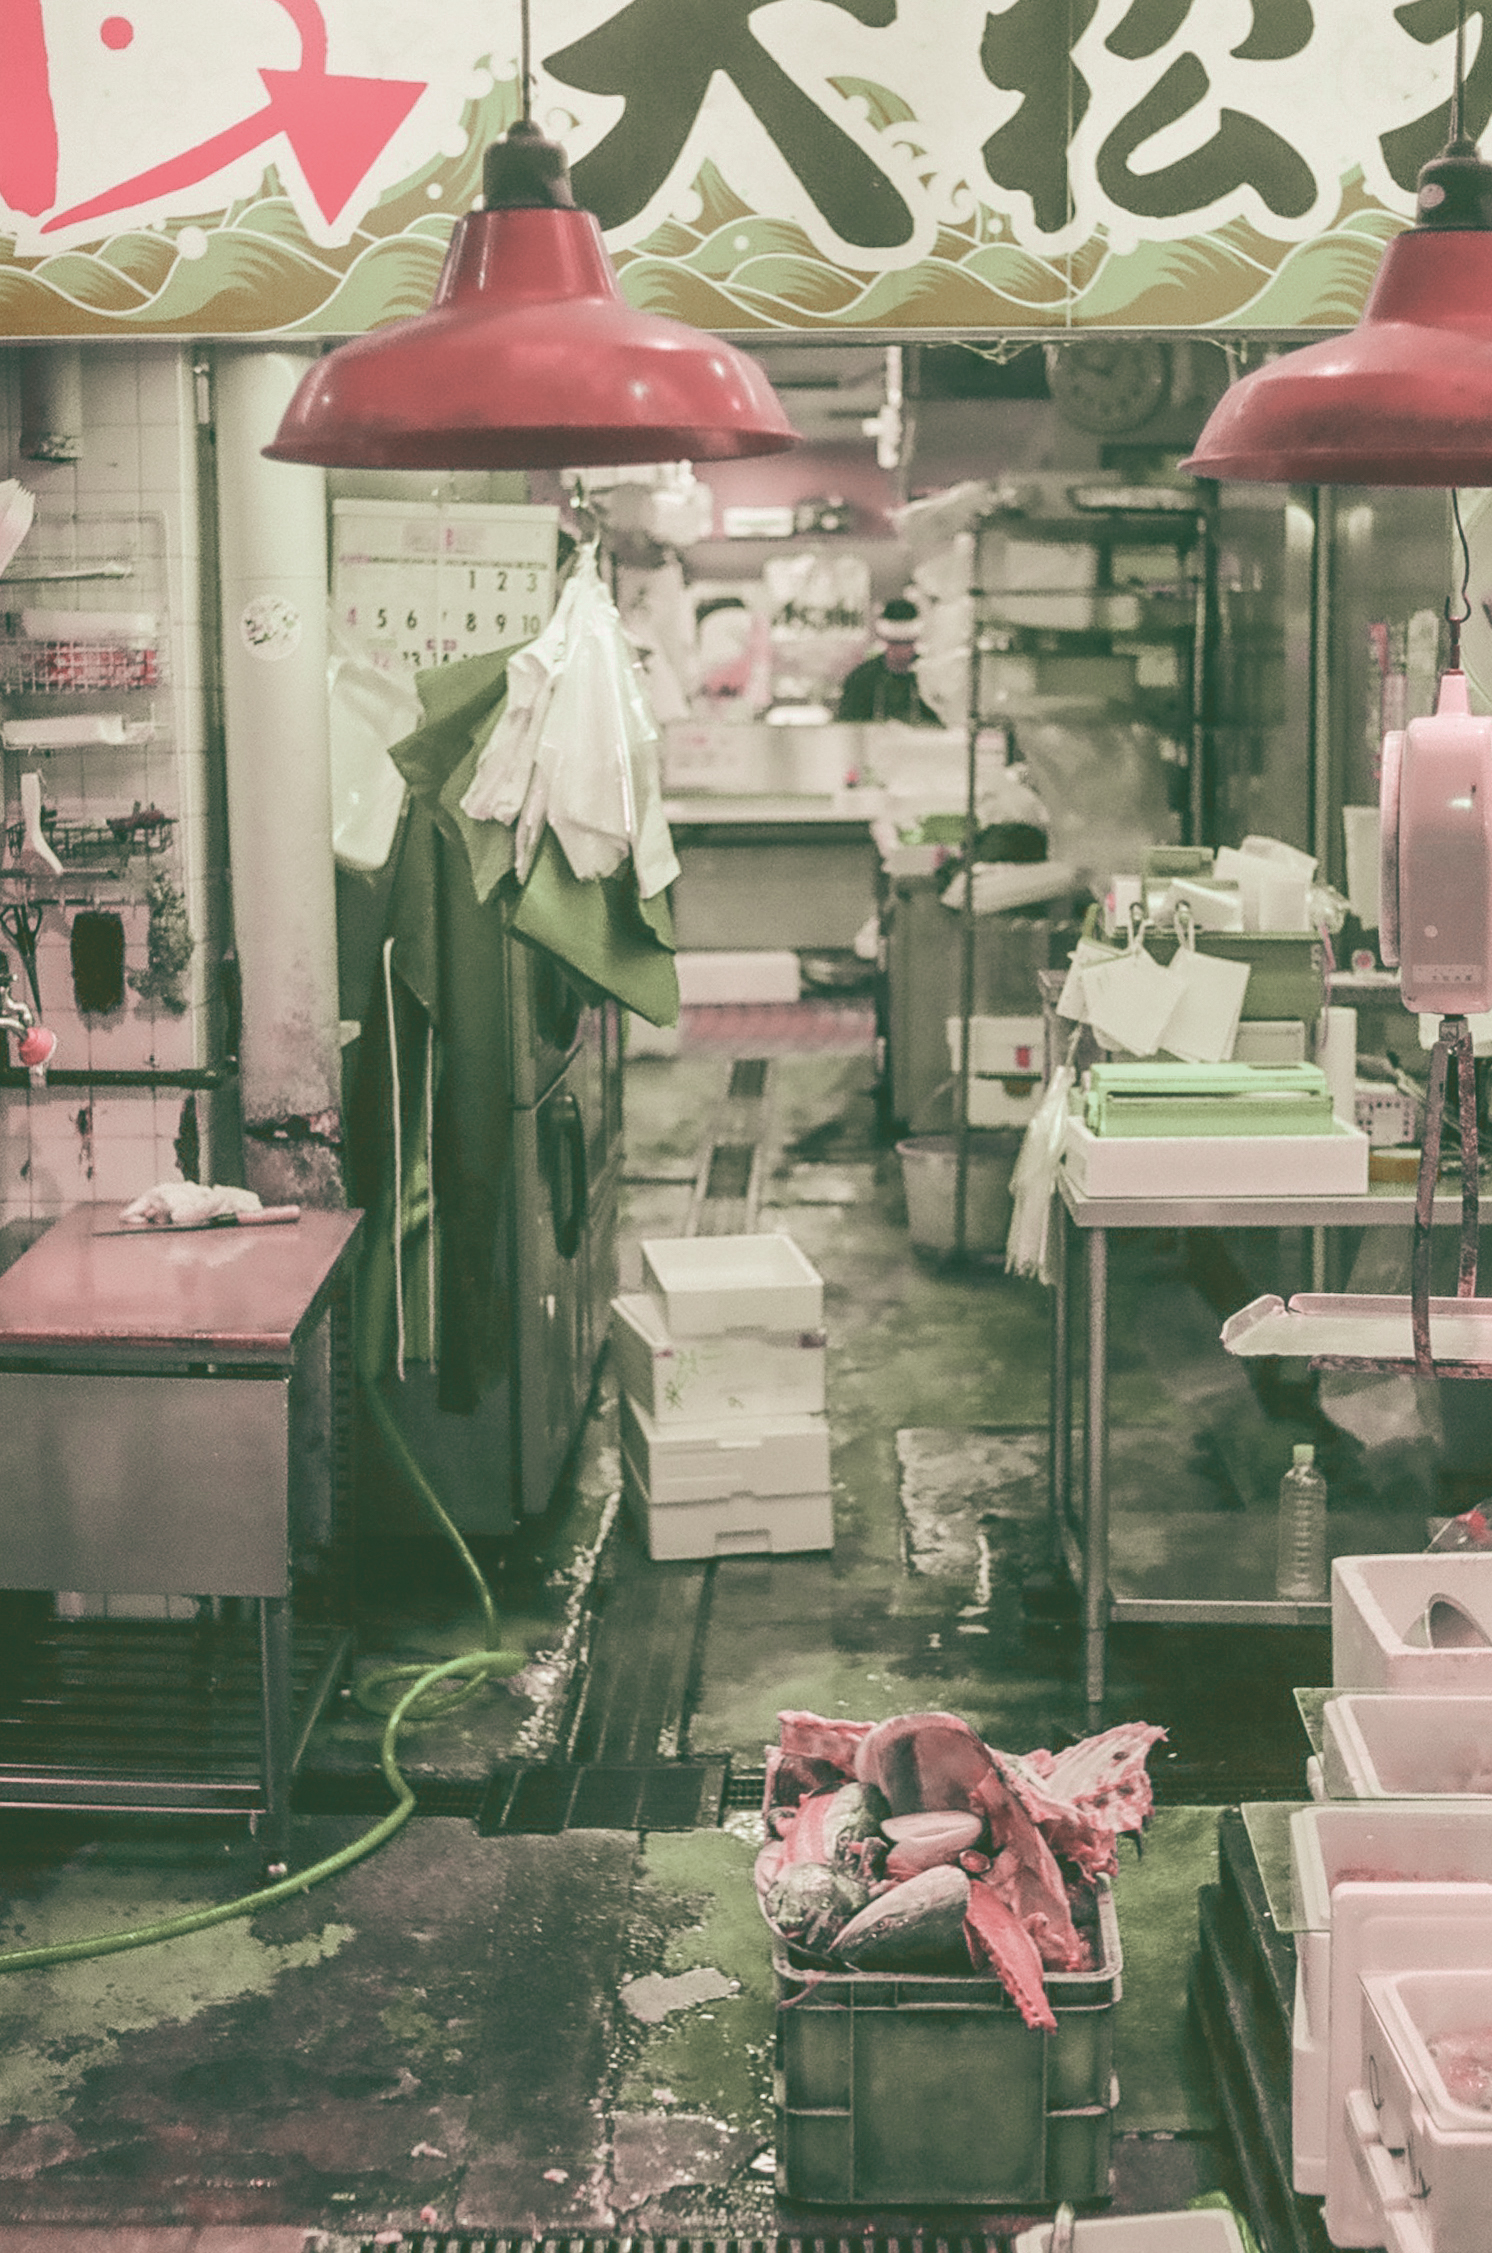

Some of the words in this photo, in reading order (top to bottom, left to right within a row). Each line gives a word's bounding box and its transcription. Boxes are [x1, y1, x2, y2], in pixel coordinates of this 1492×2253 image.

[470, 571, 476, 589] 1
[497, 571, 507, 592] 2
[526, 572, 538, 592] 3
[347, 605, 358, 626] 4
[376, 607, 387, 629] 5
[407, 609, 418, 630] 6
[466, 612, 478, 632] 8
[496, 613, 506, 633] 9
[522, 614, 541, 635] 10
